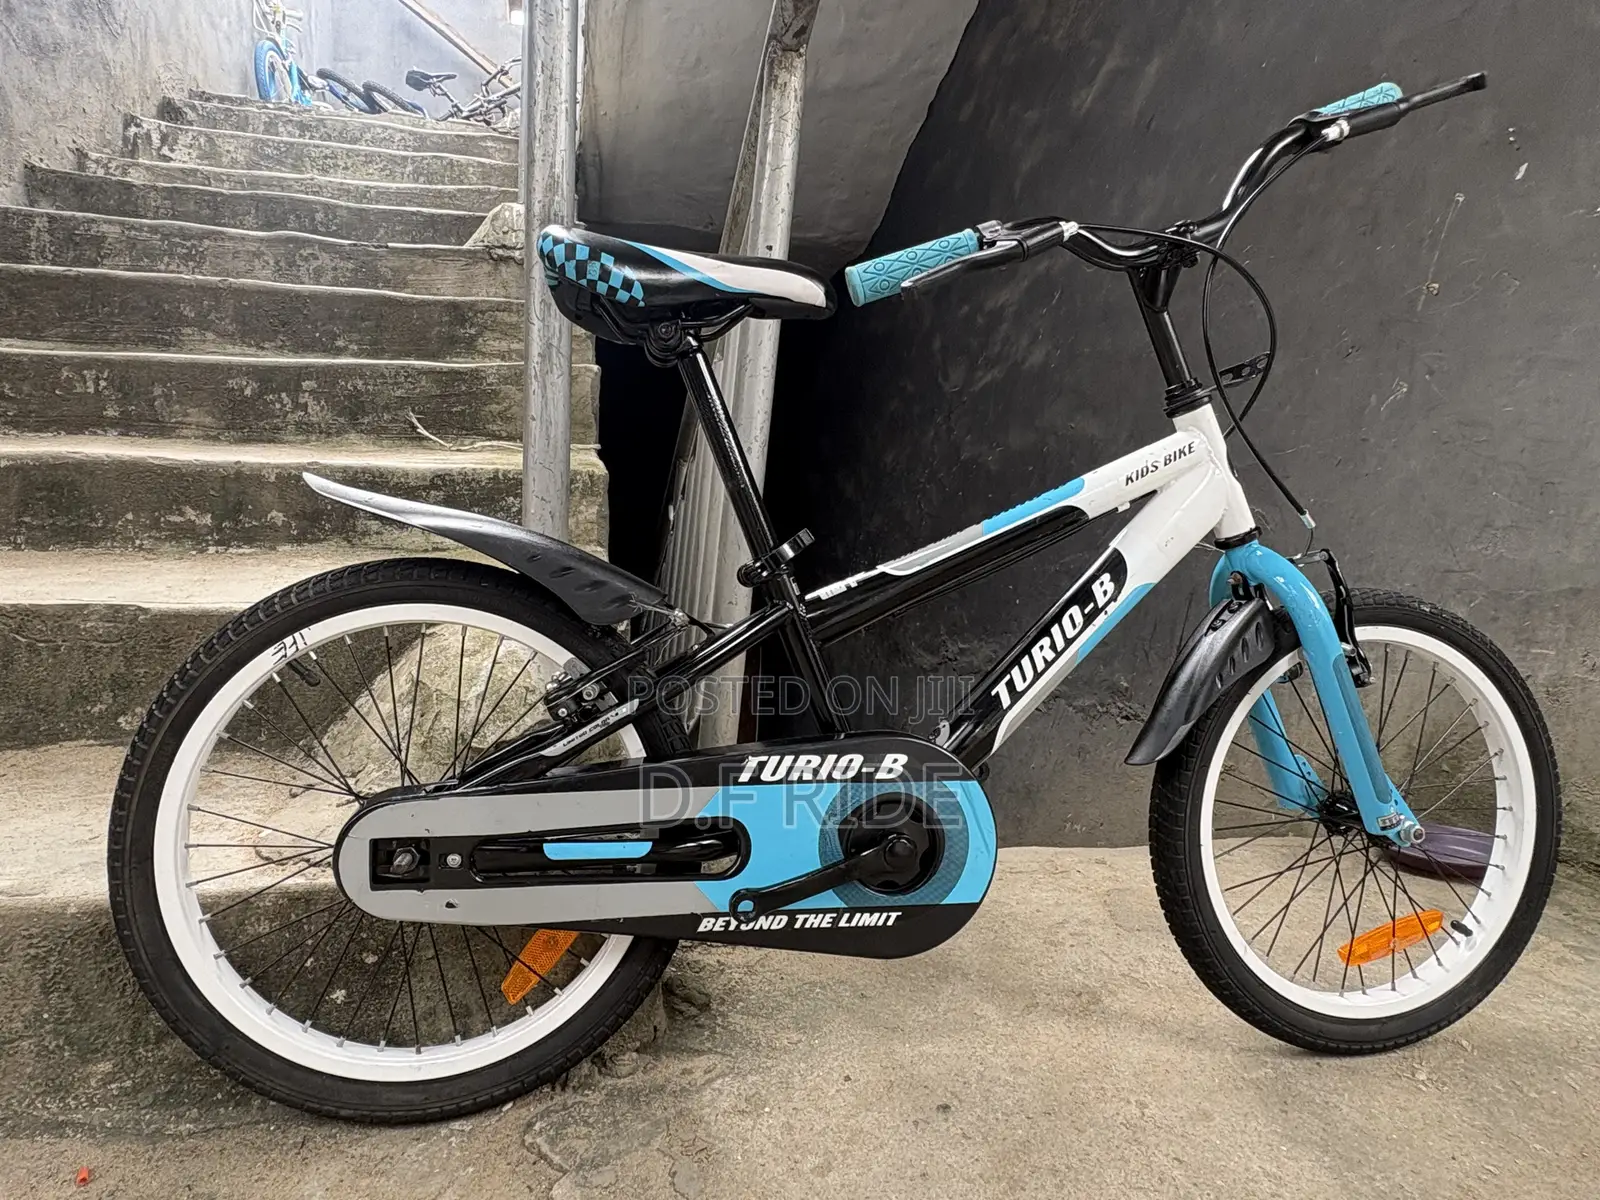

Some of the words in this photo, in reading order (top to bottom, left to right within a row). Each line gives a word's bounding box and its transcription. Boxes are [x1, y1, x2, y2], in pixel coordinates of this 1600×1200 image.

[1124, 460, 1159, 487] KIDS
[1163, 441, 1196, 467] BIKE
[991, 572, 1115, 710] TURIO-B
[738, 753, 909, 783] TURIO-B
[793, 913, 833, 930] THE
[838, 911, 902, 928] LIMIT
